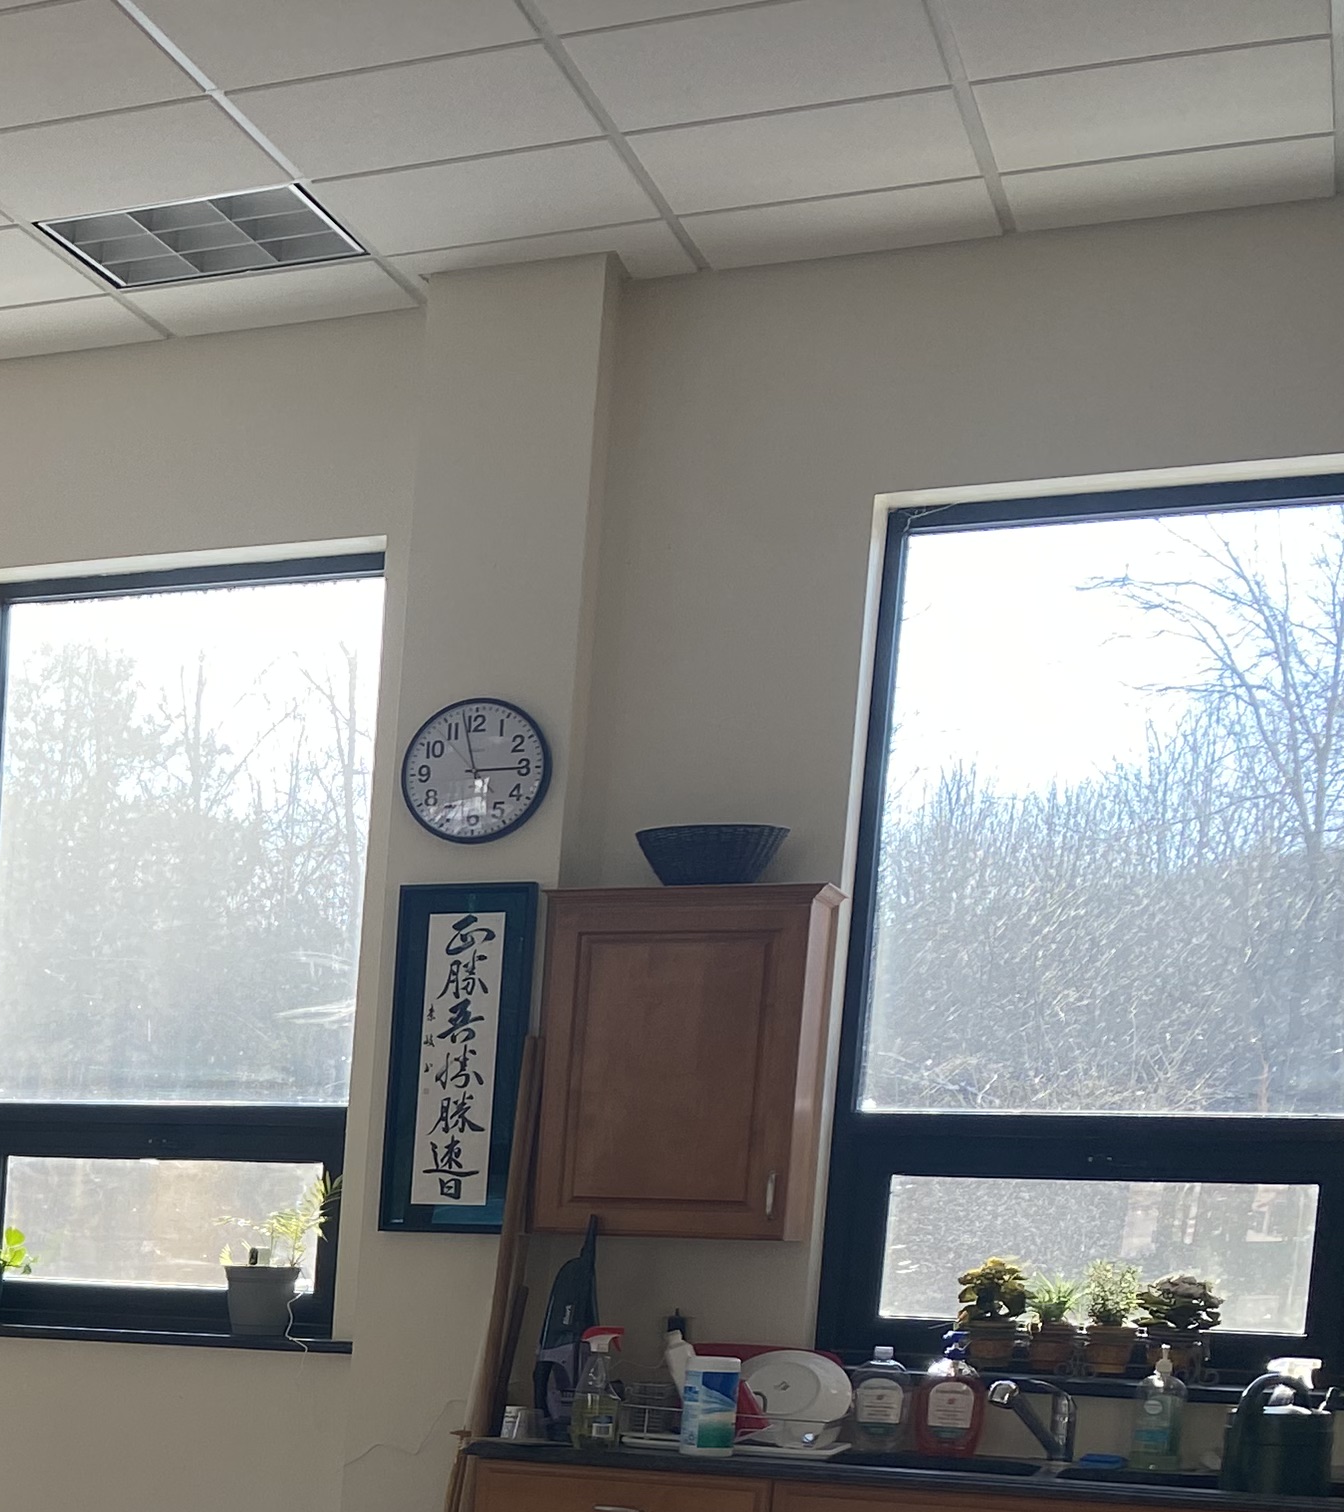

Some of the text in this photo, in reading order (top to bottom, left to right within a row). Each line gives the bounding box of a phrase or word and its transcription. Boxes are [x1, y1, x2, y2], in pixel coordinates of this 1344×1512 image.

[447, 722, 459, 740] 11
[467, 714, 487, 733] 12
[499, 719, 504, 737] 1
[426, 740, 444, 759] 10
[511, 734, 525, 753] 2
[418, 765, 431, 783] 9
[517, 758, 530, 777] 3
[424, 789, 438, 807] 8
[509, 783, 522, 801] 4
[491, 801, 505, 819] 5
